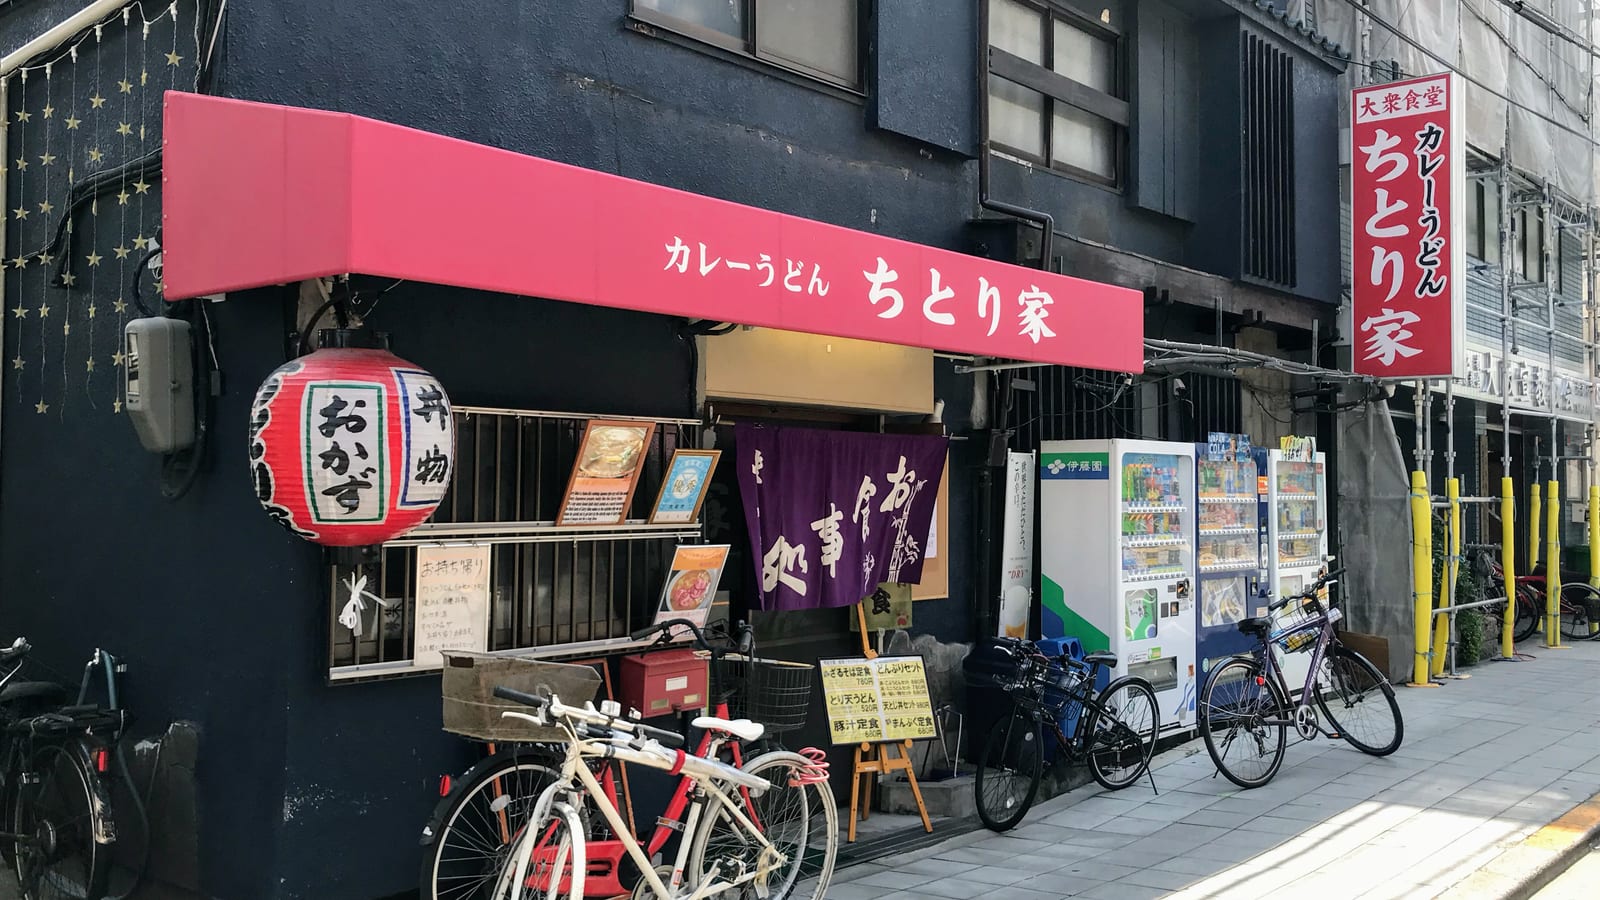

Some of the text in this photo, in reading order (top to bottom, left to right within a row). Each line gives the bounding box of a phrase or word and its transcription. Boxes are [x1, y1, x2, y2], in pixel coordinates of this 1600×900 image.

[1360, 85, 1445, 117] 大衆食堂
[1415, 123, 1447, 298] カレーうどん
[1358, 128, 1424, 367] ちとり家
[663, 235, 1057, 344] カレーうどん ちとり家
[318, 395, 377, 515] おかず
[1066, 460, 1102, 472] 伊藤園
[763, 455, 916, 596] お食事処
[421, 558, 483, 578] お持ち帰り
[871, 587, 891, 615] 食
[877, 662, 922, 675] どんぶりセット
[830, 692, 876, 706] とり天うどん
[833, 717, 880, 732] 豚汁定食
